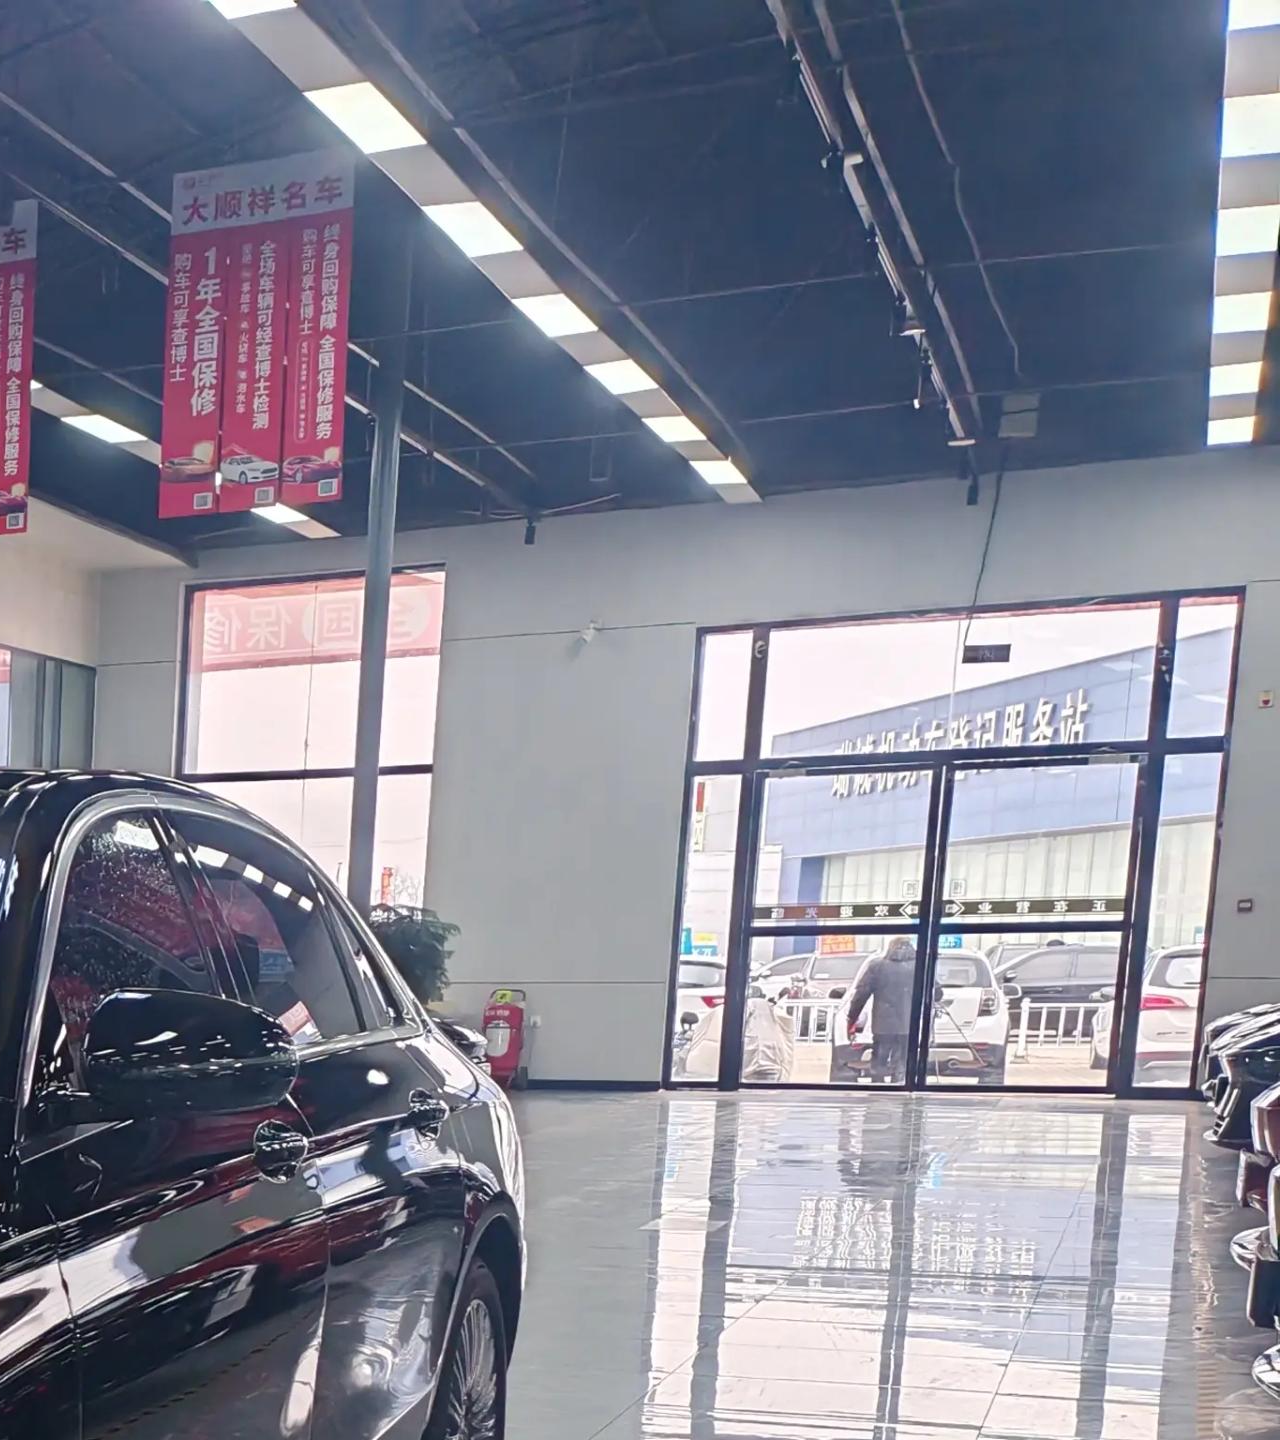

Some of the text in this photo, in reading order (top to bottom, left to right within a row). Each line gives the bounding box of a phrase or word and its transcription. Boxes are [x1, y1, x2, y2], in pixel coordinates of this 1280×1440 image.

[182, 176, 343, 226] 大顺祥名车
[191, 247, 222, 417] 1年全国保修
[316, 334, 337, 440] 全国保修服务
